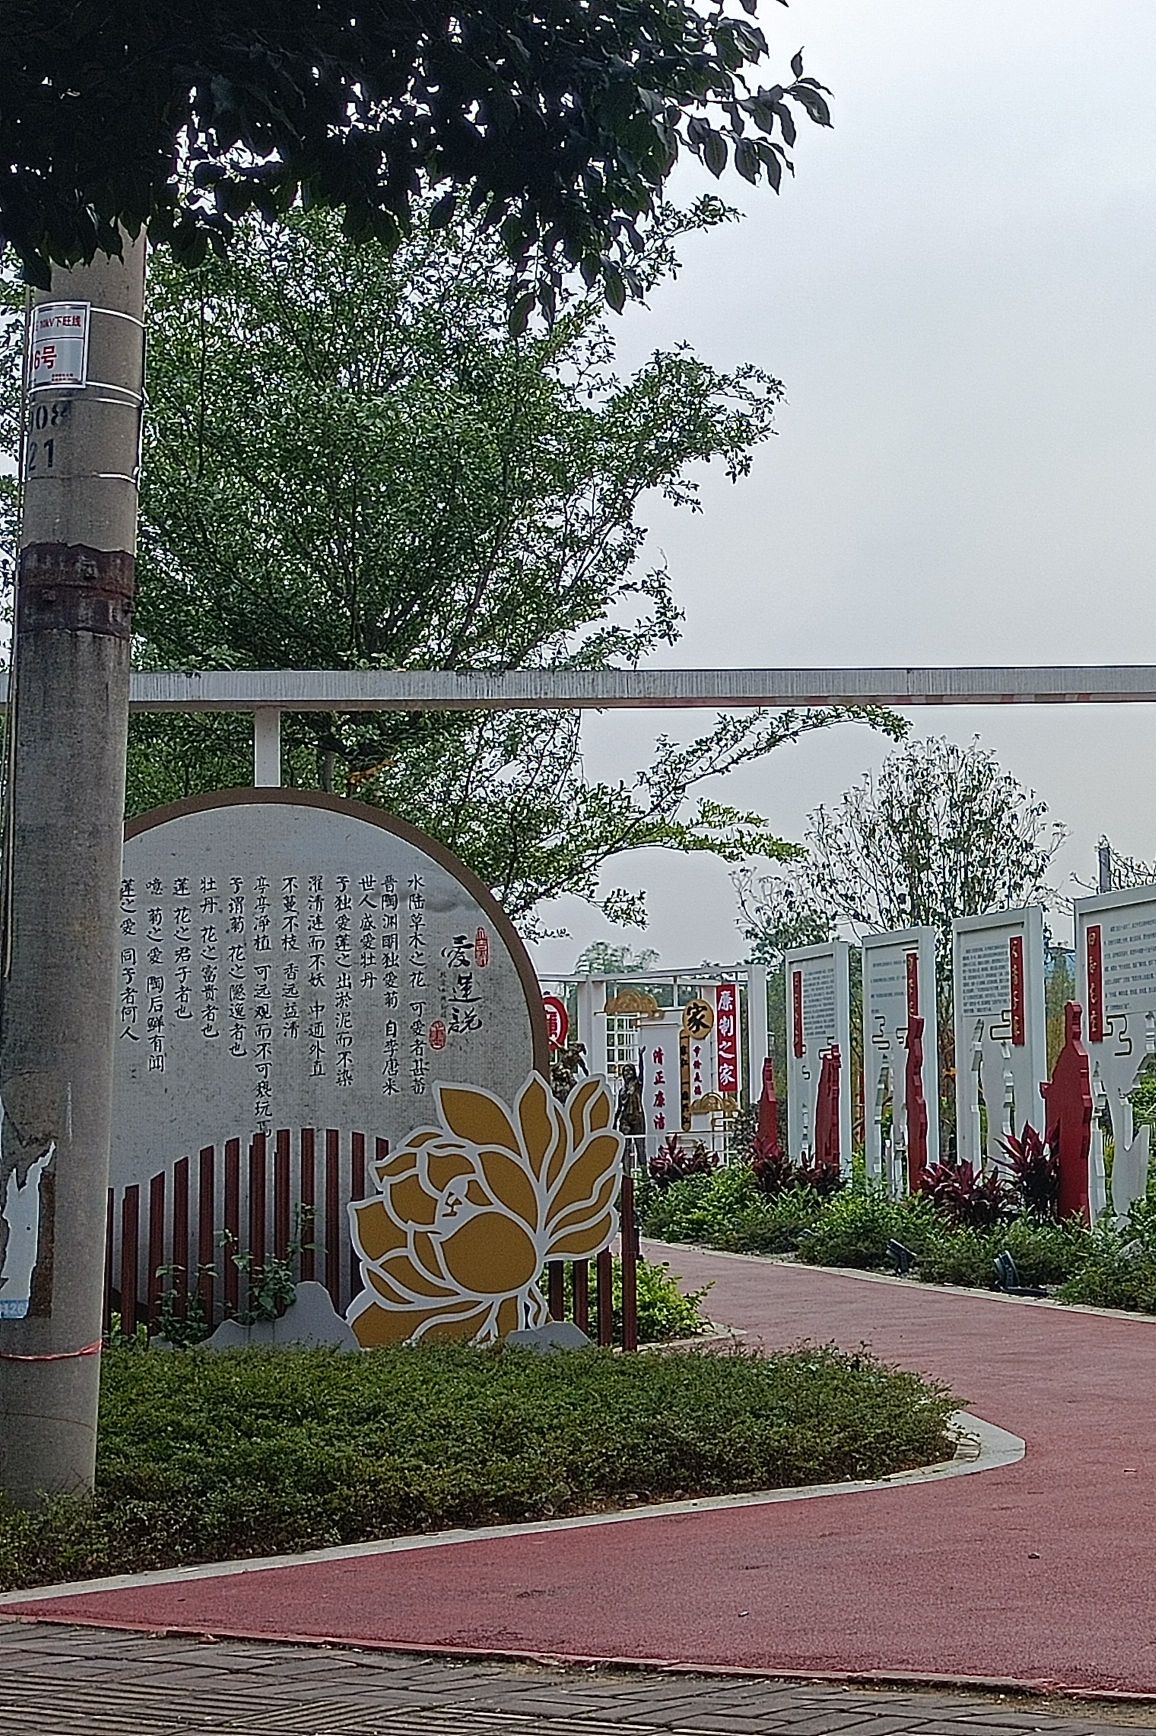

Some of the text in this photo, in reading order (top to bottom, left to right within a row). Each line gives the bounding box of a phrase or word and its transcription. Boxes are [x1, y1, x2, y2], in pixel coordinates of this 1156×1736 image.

[358, 874, 378, 989] 世人盛爱牡丹
[686, 1002, 711, 1034] 家
